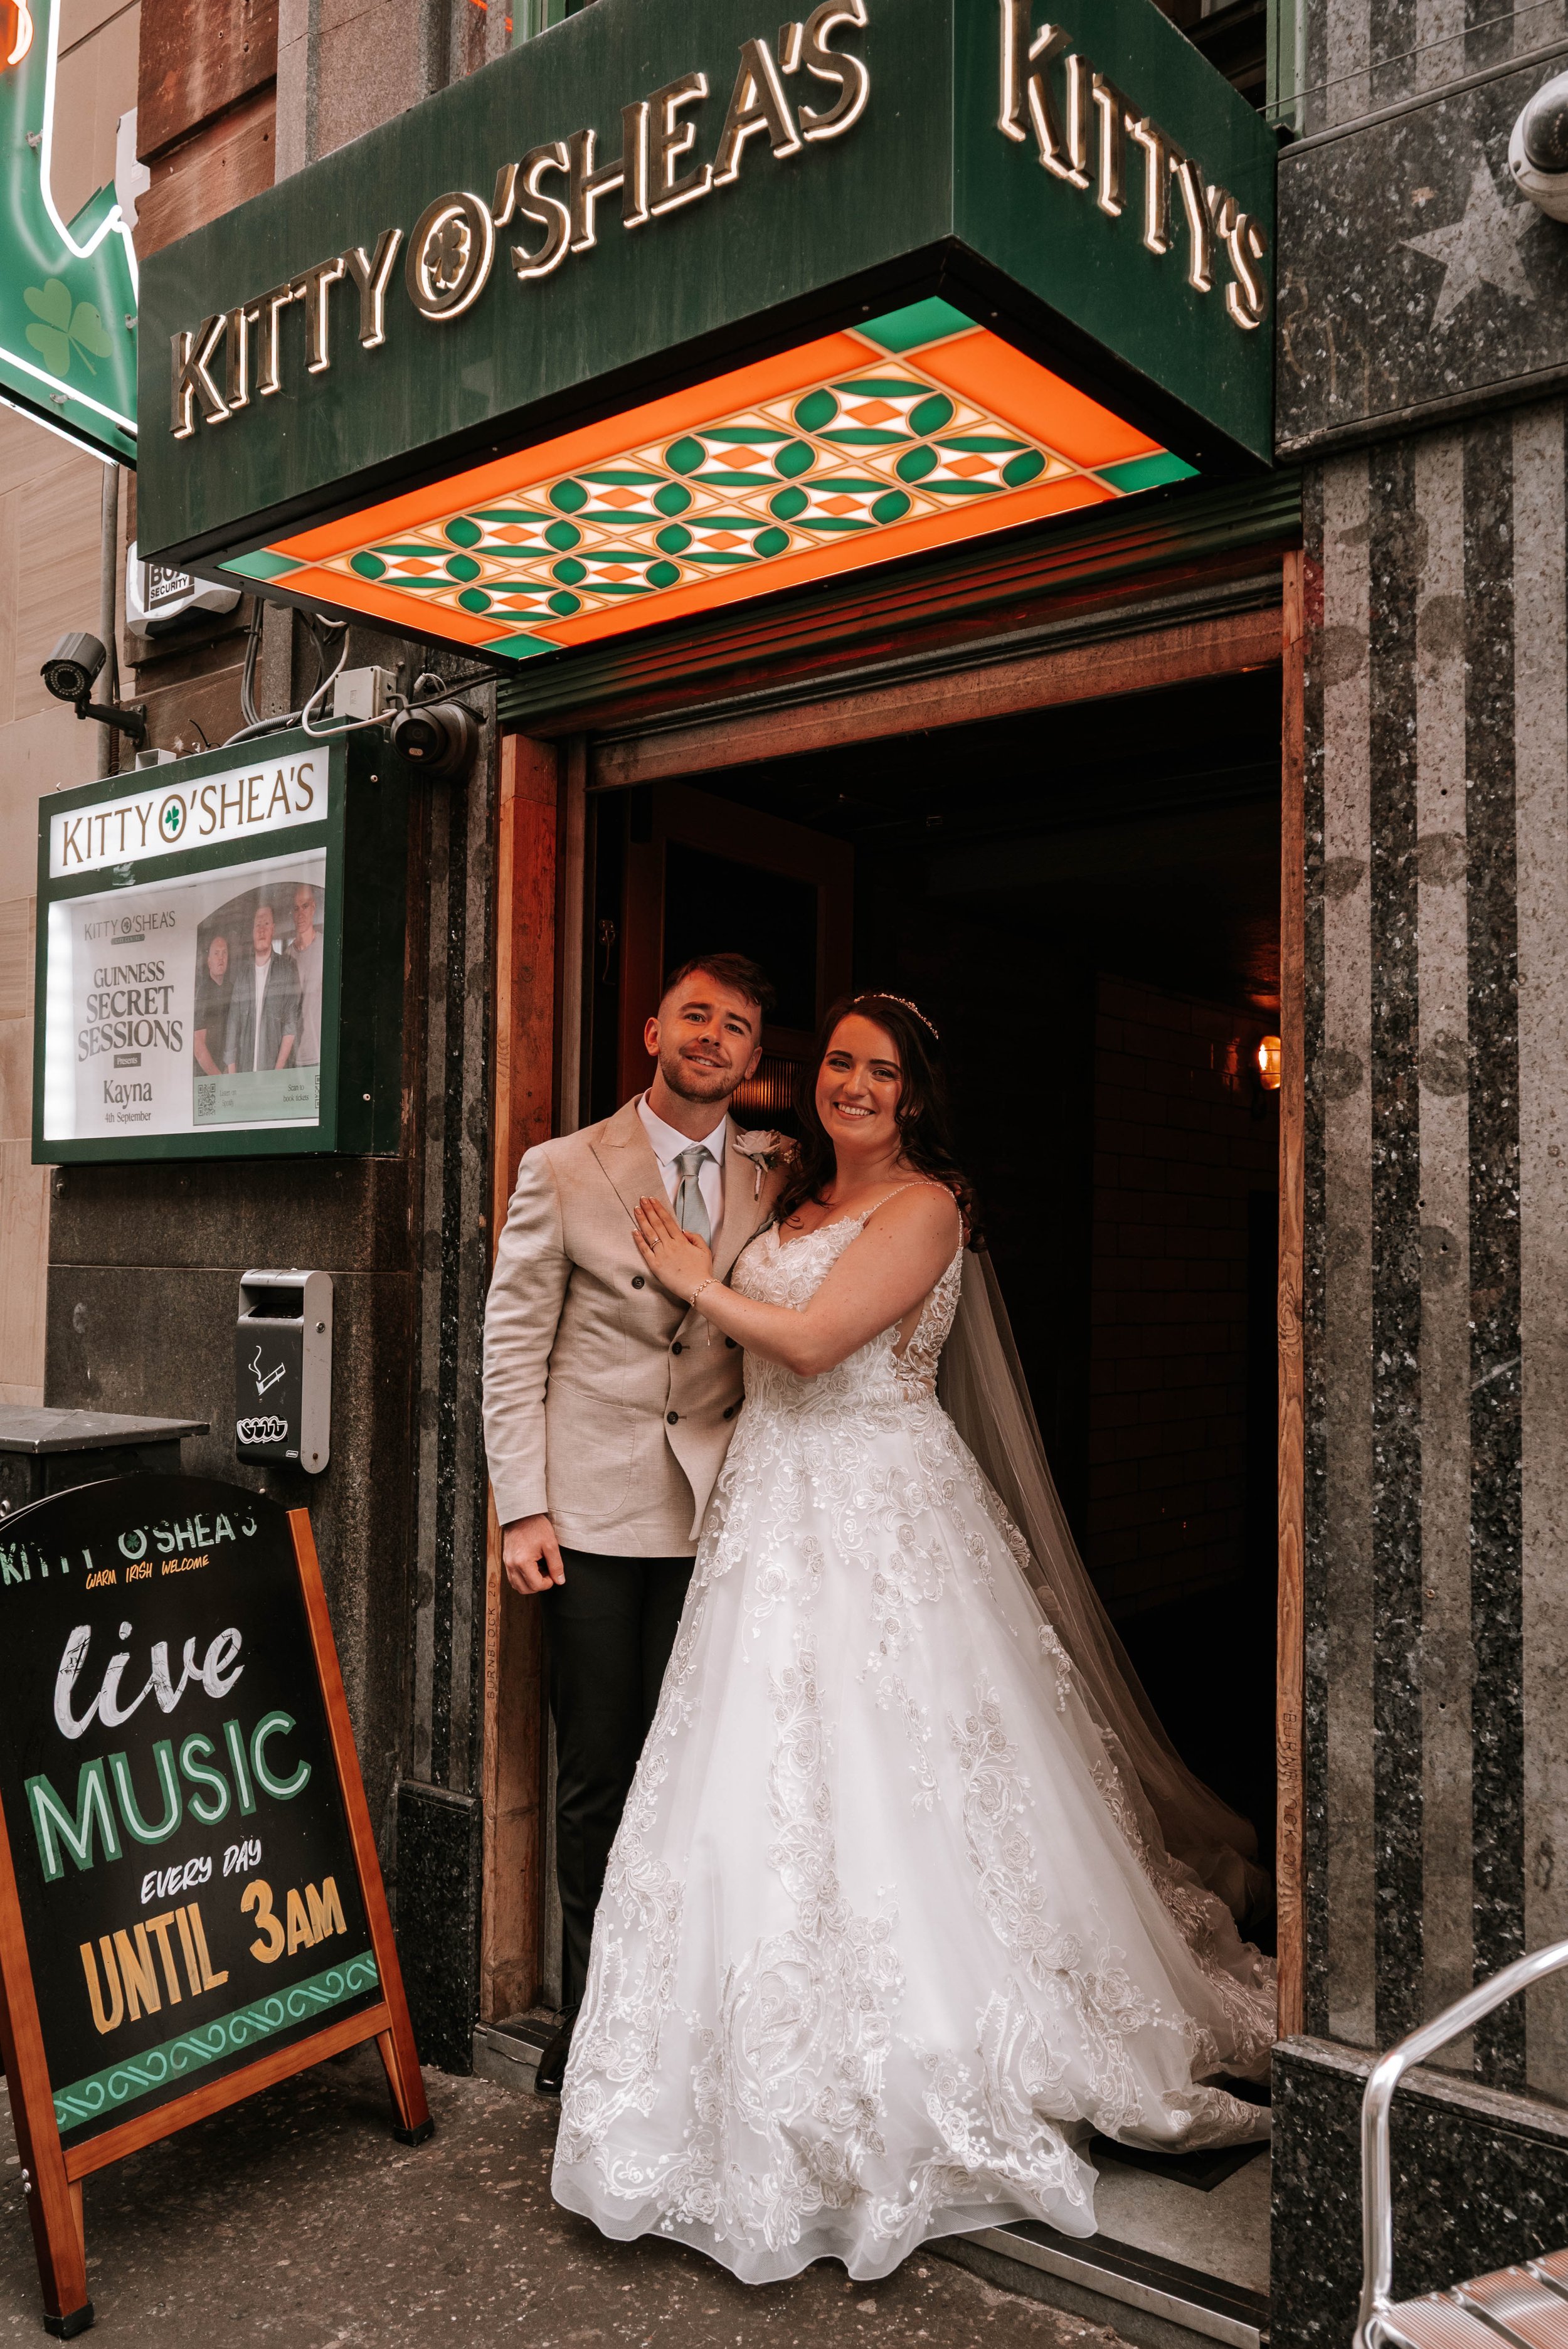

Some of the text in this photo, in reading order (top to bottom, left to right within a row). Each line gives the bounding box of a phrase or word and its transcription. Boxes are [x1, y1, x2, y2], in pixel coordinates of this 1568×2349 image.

[997, 0, 1269, 330] KITTY'S
[169, 0, 871, 439] KITTY O'SHEA'S
[151, 565, 183, 588] BO
[151, 576, 188, 599] SECURITY
[63, 763, 314, 866] KITTY O'SHEA'S
[84, 911, 176, 941] KITTY O'SHEA'S
[94, 960, 165, 989] GUINNESS
[87, 985, 174, 1024] SECRET
[78, 1019, 183, 1062] SESSIONS
[117, 1057, 138, 1065] Presents
[103, 1079, 153, 1110] Kayna
[105, 1111, 151, 1124] 4th September
[118, 1506, 257, 1559] OSHEA
[86, 1554, 210, 1589] WARM IRISH WELCOME
[54, 1621, 244, 1739] live
[24, 1710, 312, 1882] MUSIC
[140, 1838, 262, 1904] EVERY DAY
[80, 1877, 348, 2035] UNTIL 3AM
